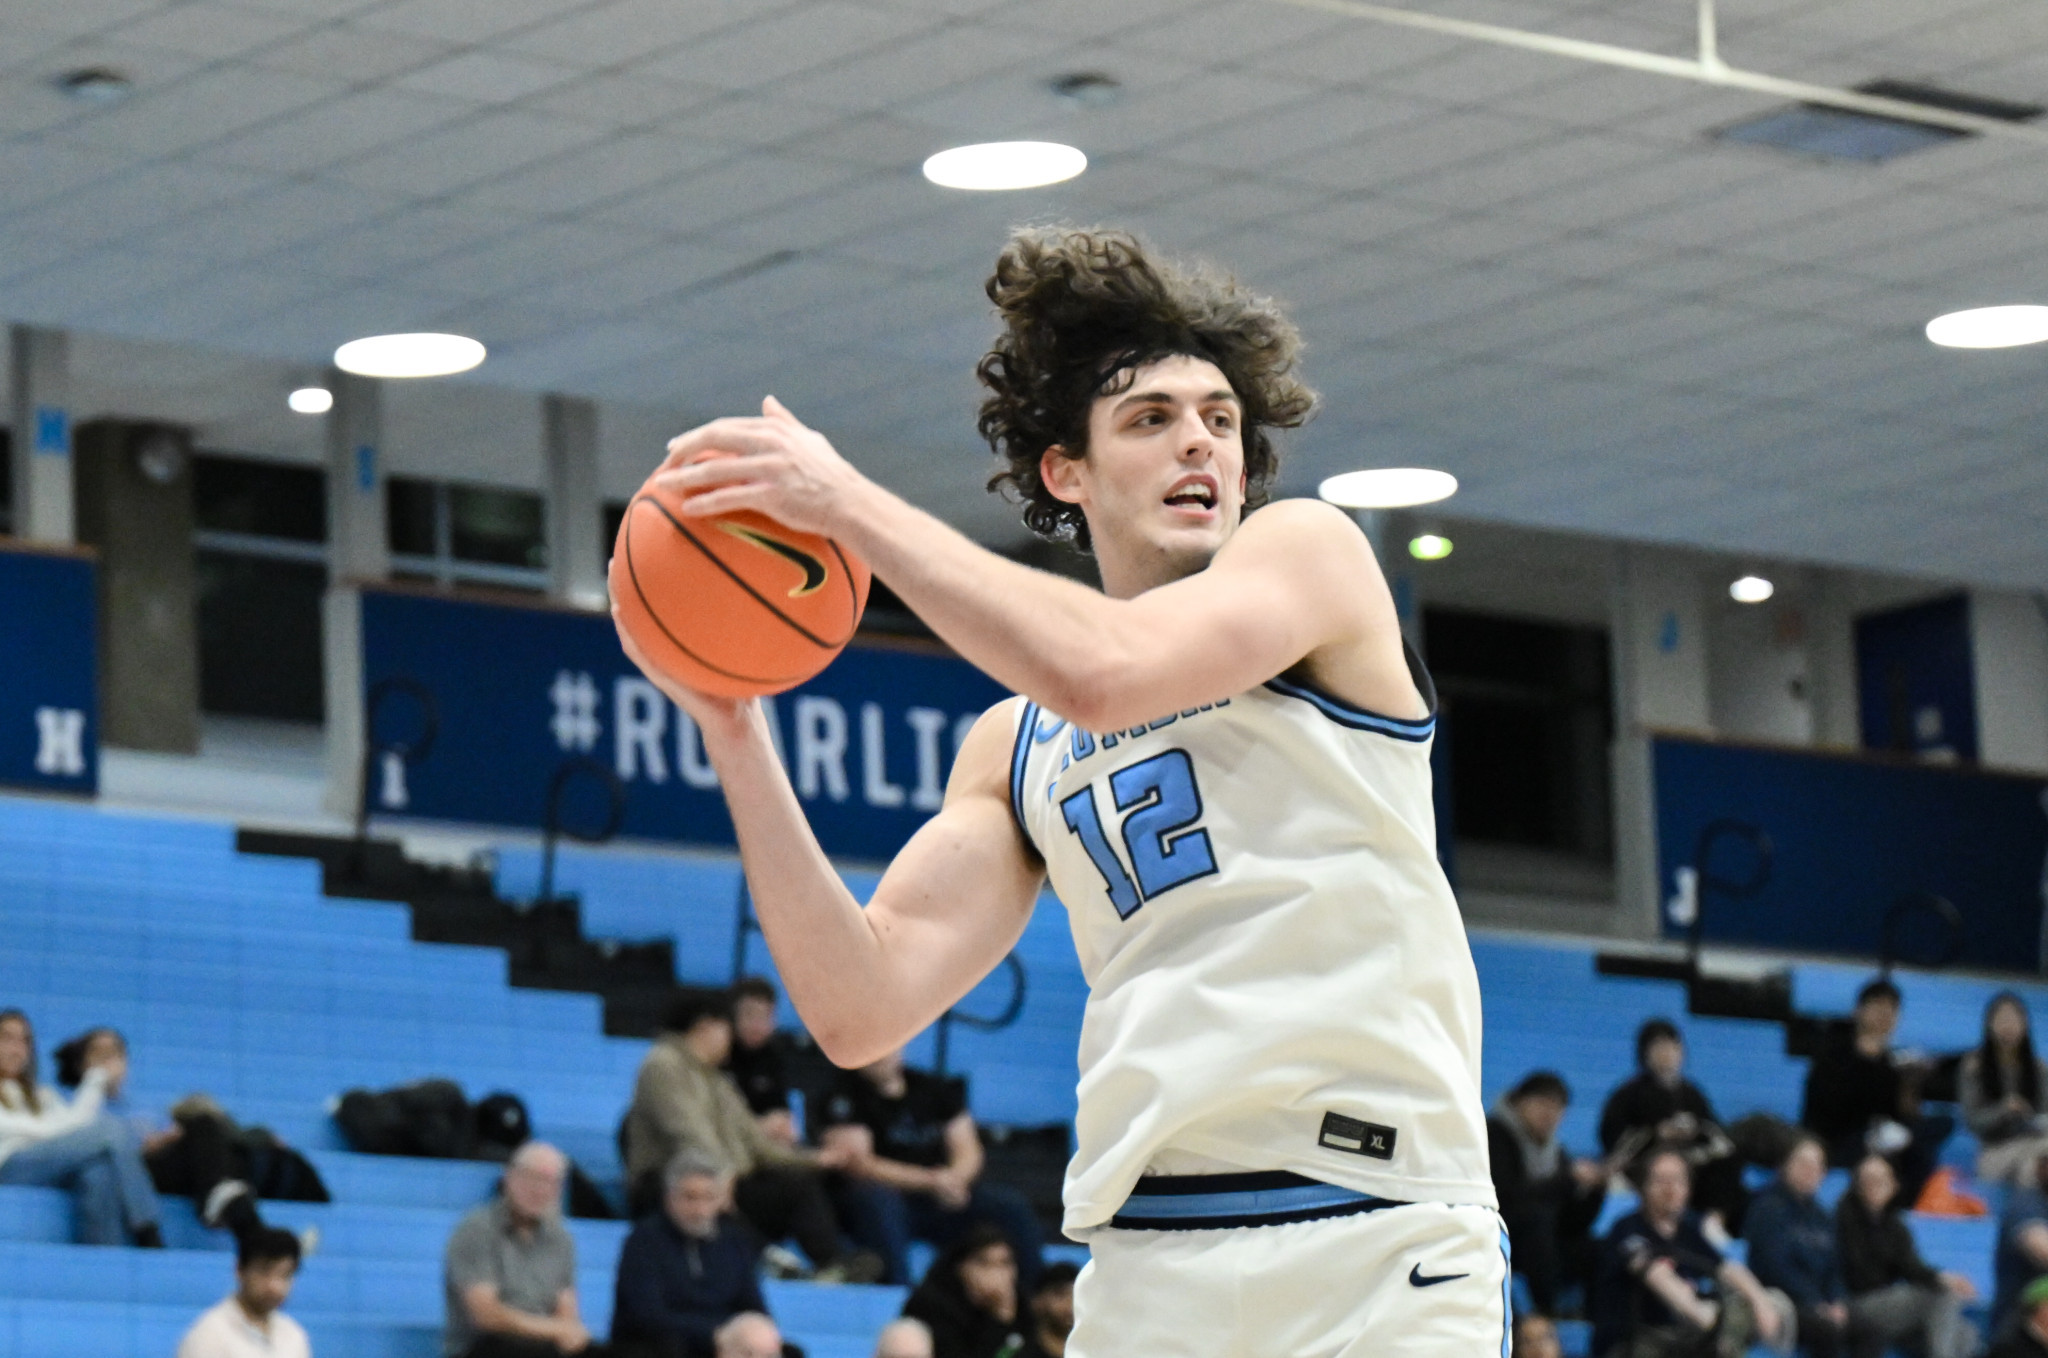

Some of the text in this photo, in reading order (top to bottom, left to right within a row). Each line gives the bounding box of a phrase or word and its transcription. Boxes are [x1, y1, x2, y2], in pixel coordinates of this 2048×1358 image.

[35, 706, 86, 775] H
[1059, 747, 1219, 921] 12
[1370, 1133, 1386, 1150] XL
